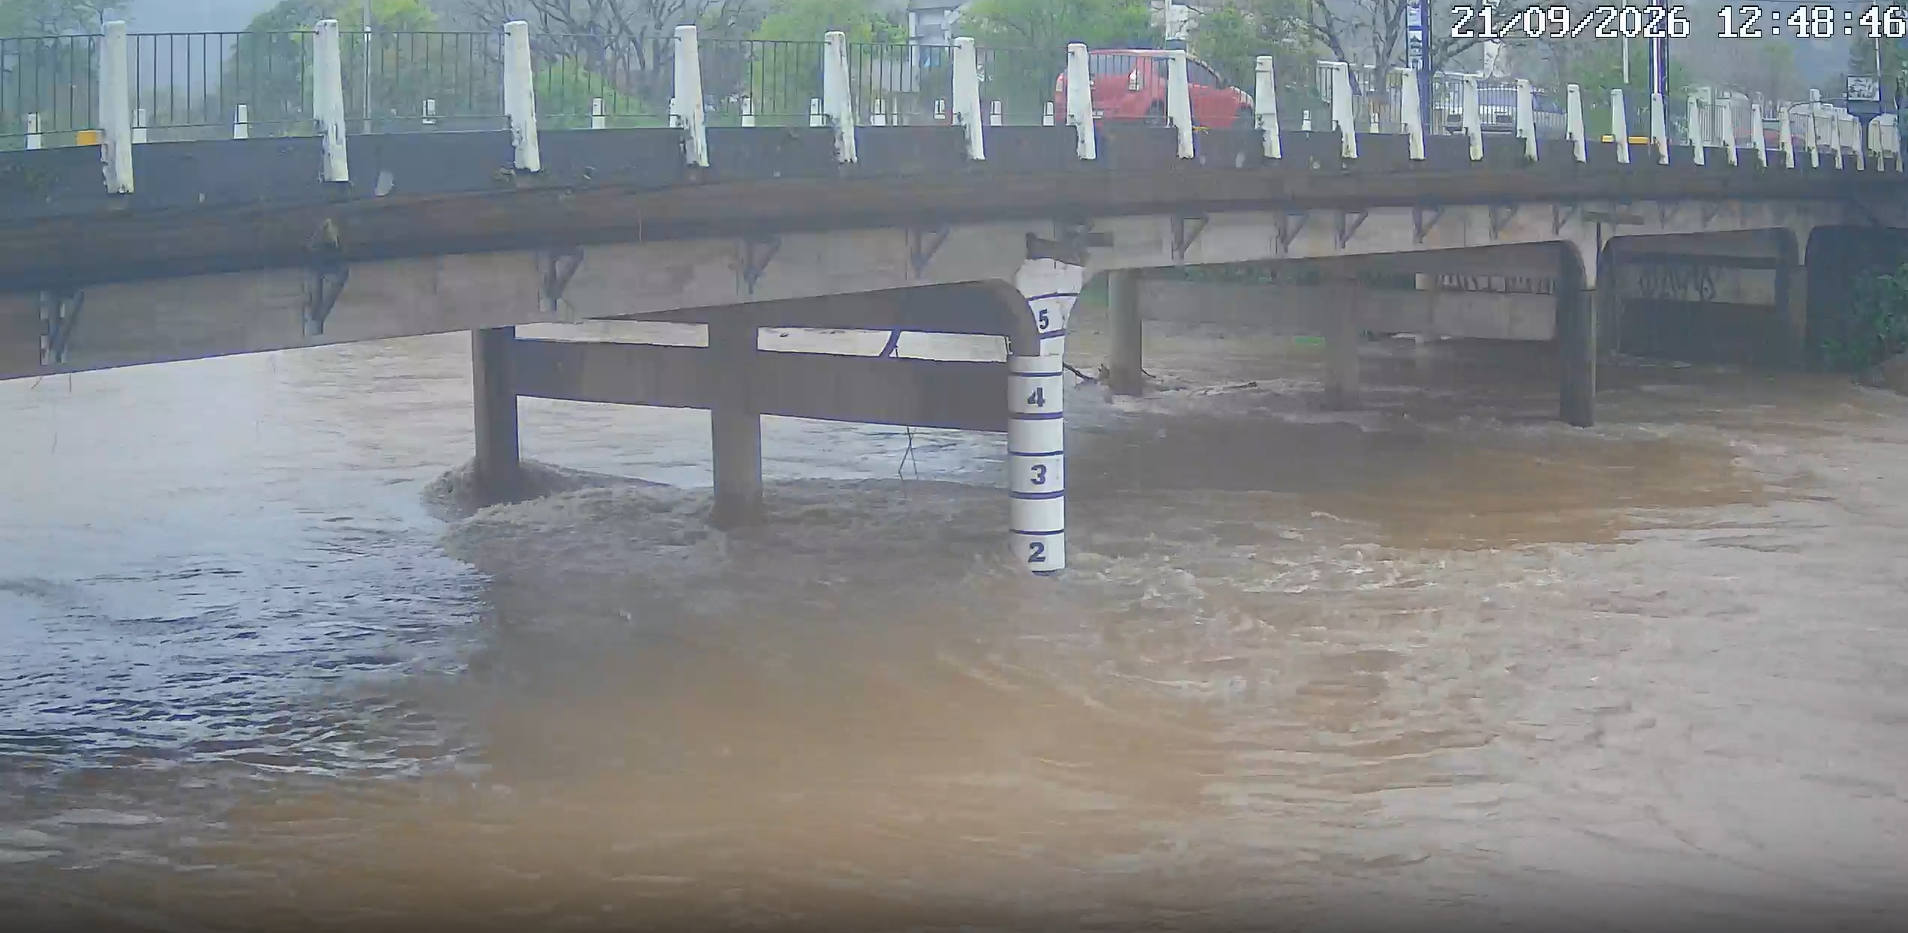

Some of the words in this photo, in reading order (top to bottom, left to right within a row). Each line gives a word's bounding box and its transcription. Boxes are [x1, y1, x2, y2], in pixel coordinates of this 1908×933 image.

[1038, 308, 1050, 330] 5
[1027, 387, 1046, 408] 4
[1030, 464, 1047, 486] 3
[1027, 541, 1046, 563] 2
